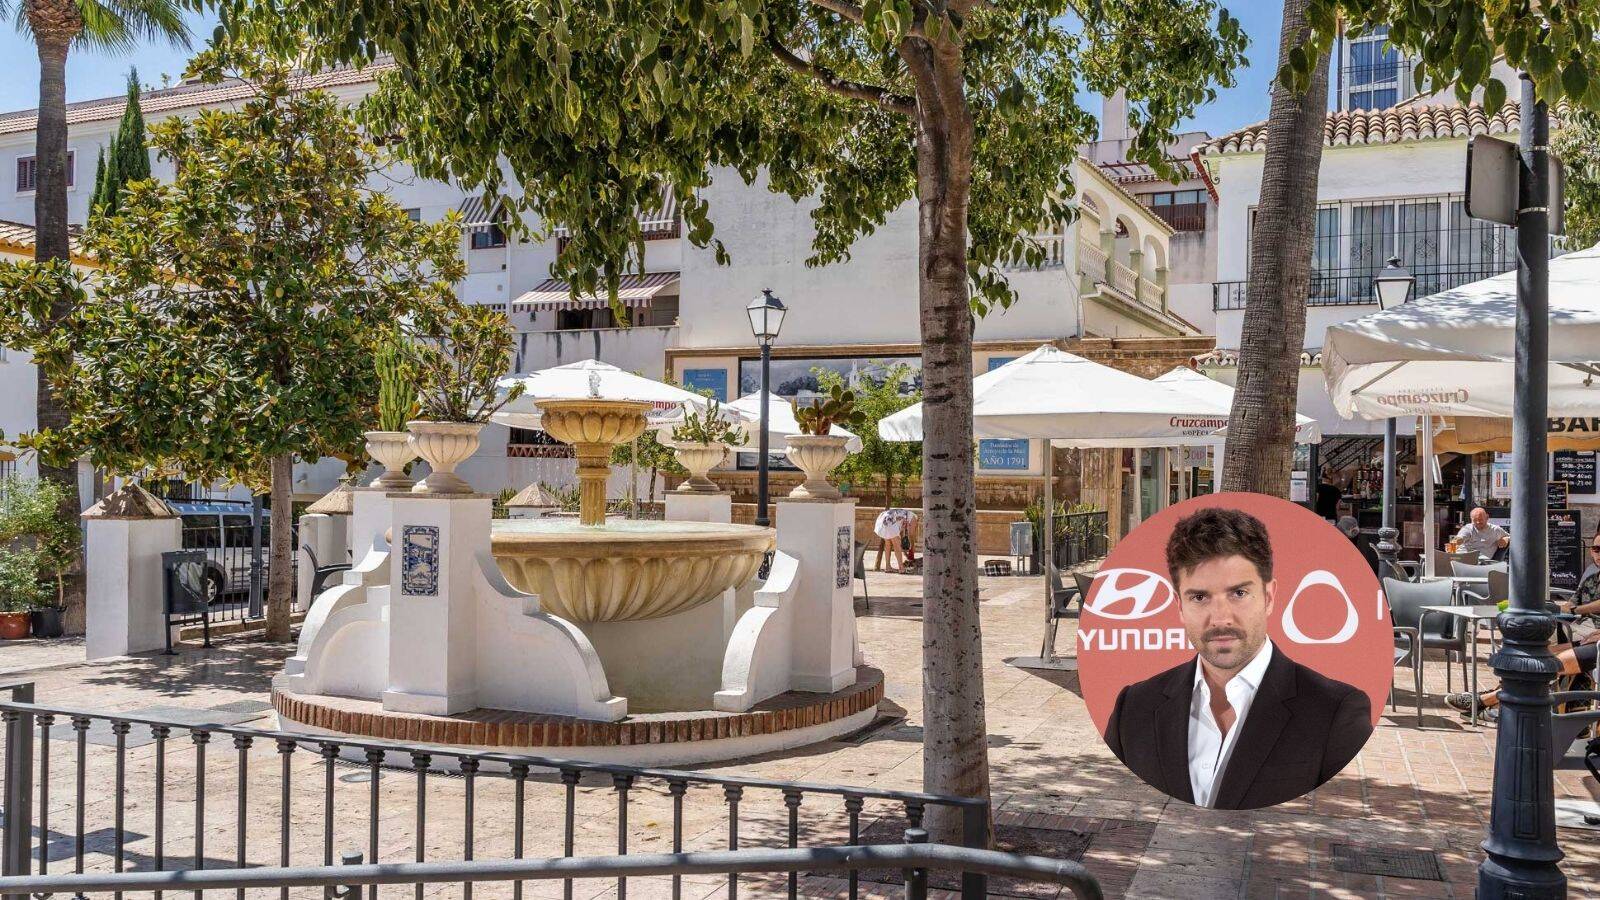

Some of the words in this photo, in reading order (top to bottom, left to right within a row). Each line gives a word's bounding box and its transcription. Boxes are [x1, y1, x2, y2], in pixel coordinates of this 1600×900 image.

[984, 455, 1004, 465] AÑO
[1007, 457, 1024, 465] 1791
[1077, 628, 1195, 651] YUNDA
